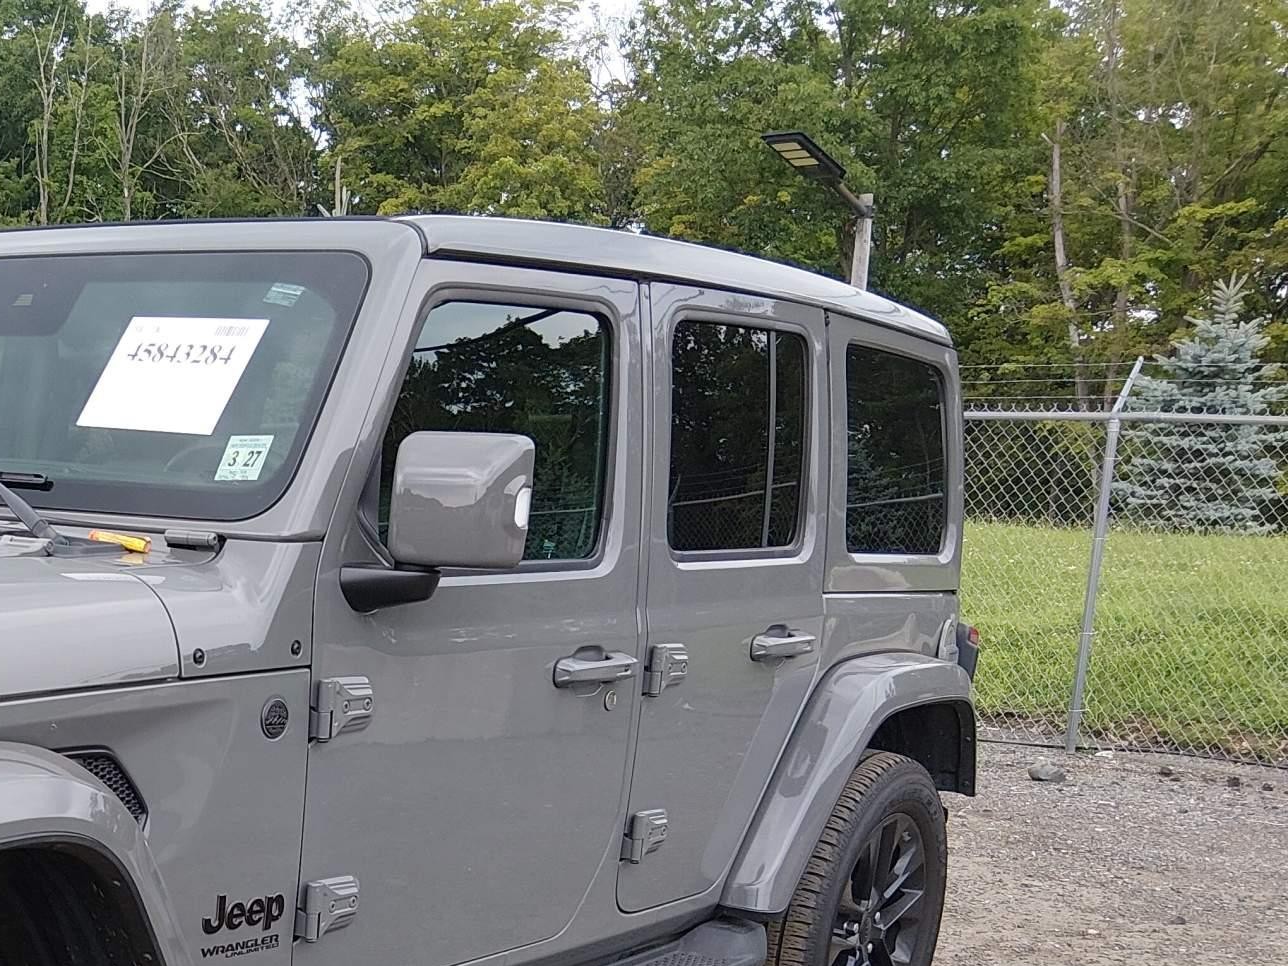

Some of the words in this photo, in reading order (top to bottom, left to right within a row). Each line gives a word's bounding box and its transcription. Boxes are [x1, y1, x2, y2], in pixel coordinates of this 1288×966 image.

[127, 342, 237, 365] 45843284
[227, 450, 240, 467] 3
[243, 450, 263, 468] 27
[201, 893, 285, 935] Jeep
[200, 934, 280, 959] WRANGLER
[225, 942, 280, 959] UNLIMITED
